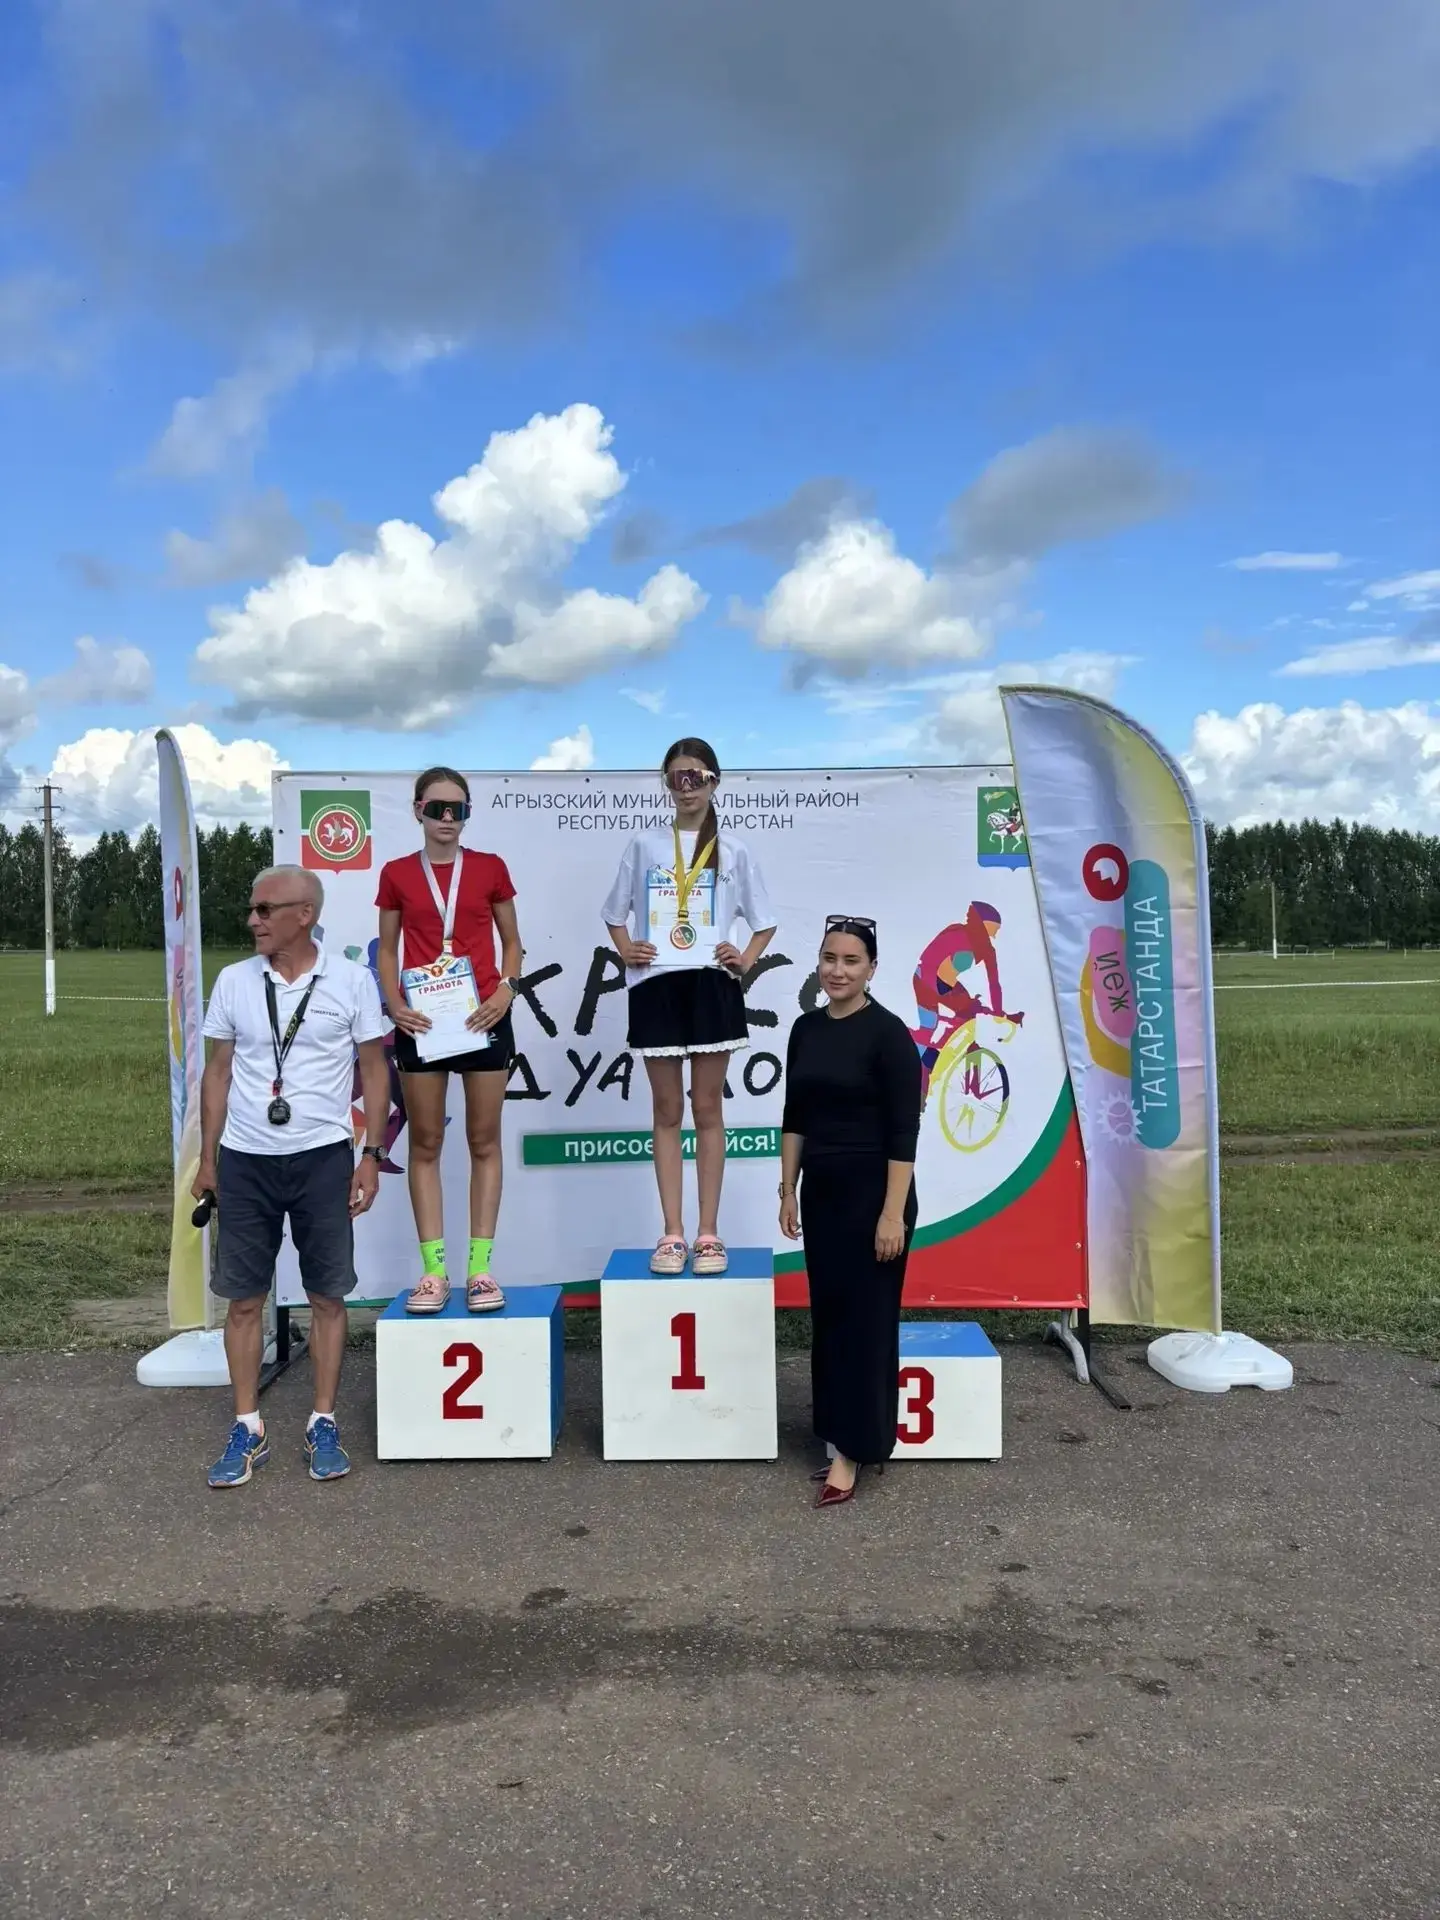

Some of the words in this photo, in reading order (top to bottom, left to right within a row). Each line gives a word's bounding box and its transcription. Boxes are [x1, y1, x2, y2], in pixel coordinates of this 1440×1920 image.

[491, 790, 606, 809] АГРЫЗСКИЙ
[612, 789, 789, 809] МУНИАЛЬНЫЙ
[795, 788, 859, 808] РАЙОН
[714, 814, 793, 830] АРСТАН
[658, 889, 703, 897] ГРАТА
[418, 979, 463, 995] ГРАМОТА
[1133, 895, 1167, 1113] ТАТАРСТАНДА
[504, 1048, 783, 1107] ДУАО
[564, 1129, 777, 1162] присоеийся!
[670, 1312, 705, 1390] 1
[442, 1342, 483, 1419] 2
[896, 1366, 935, 1444] 3
